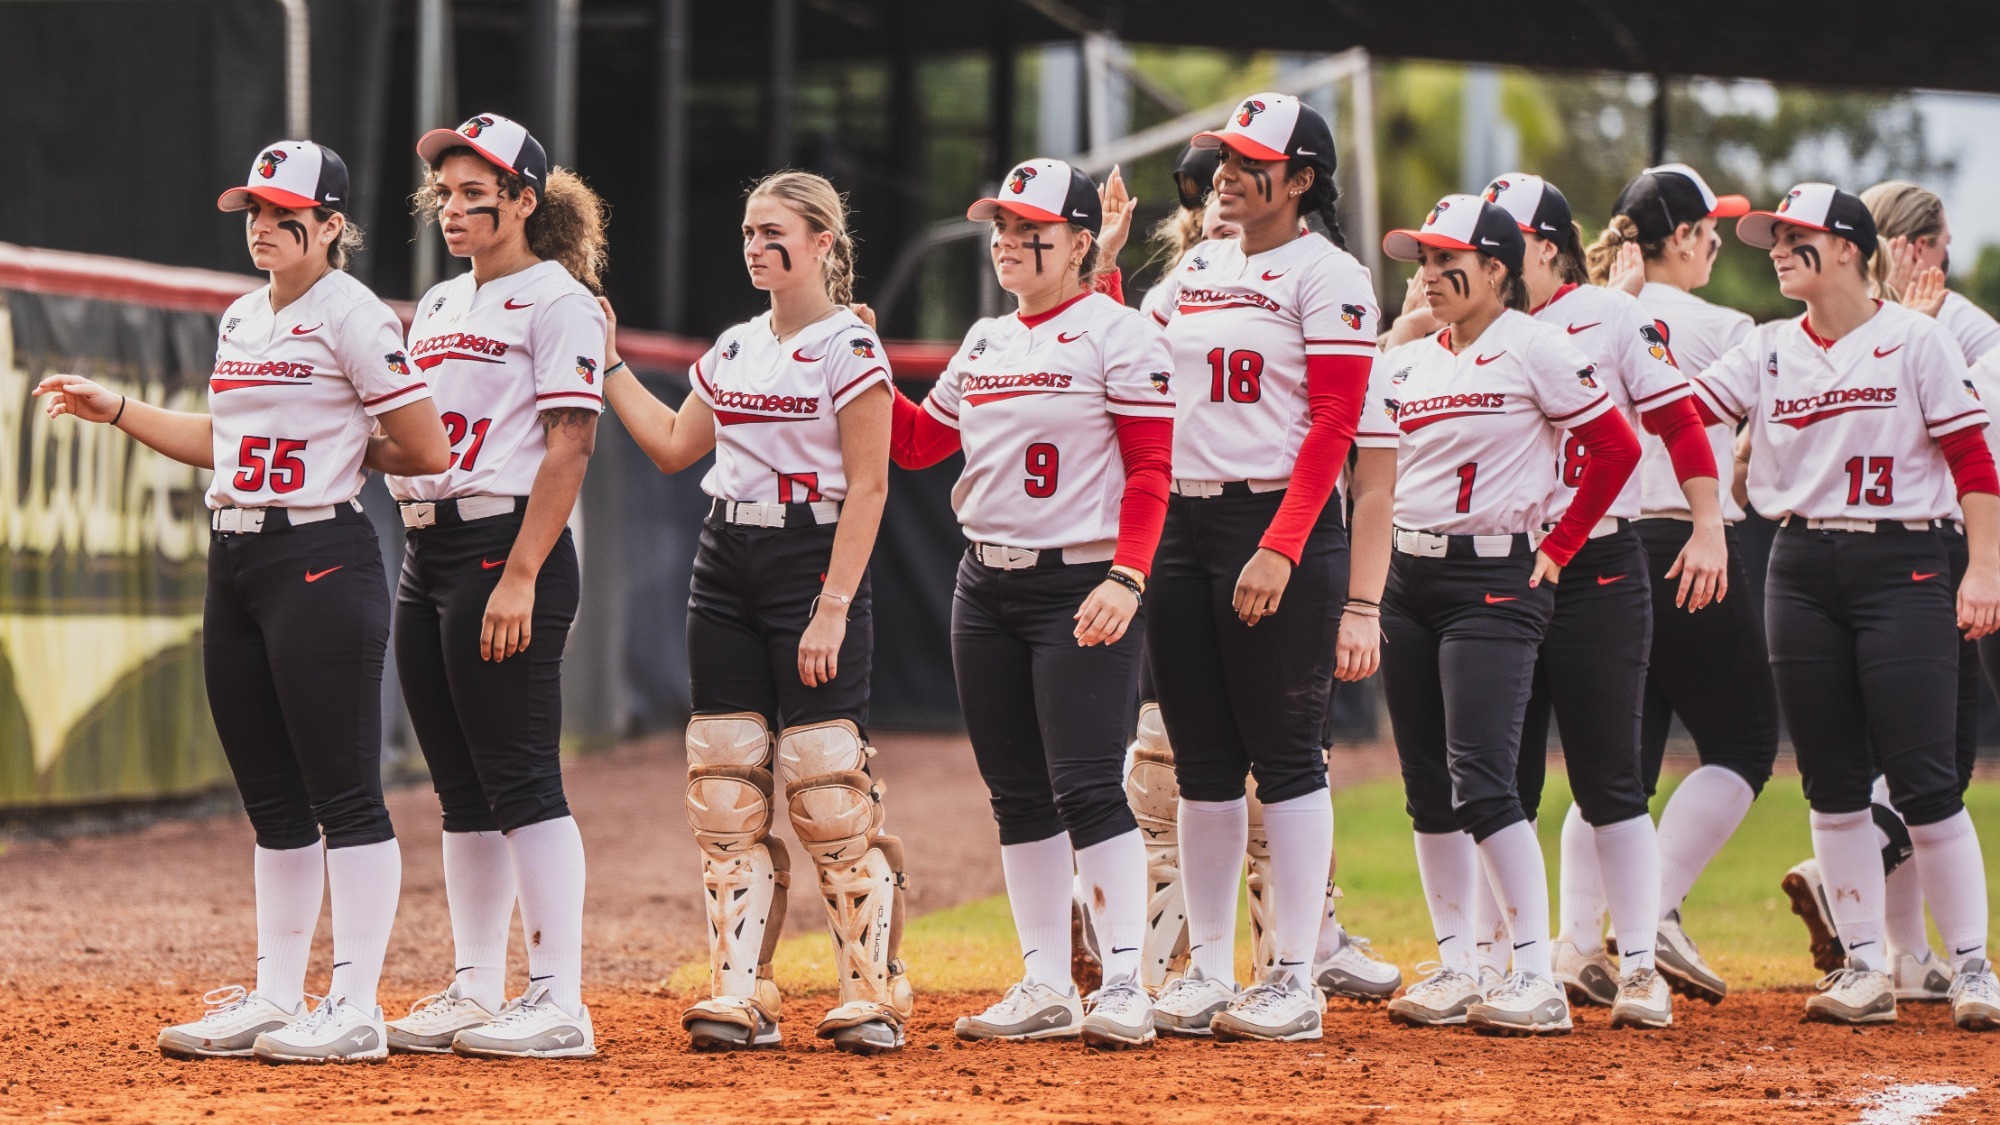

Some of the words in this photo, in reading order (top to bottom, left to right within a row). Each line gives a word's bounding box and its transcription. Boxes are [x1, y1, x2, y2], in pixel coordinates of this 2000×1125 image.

[214, 361, 314, 378] uccaneers
[1207, 347, 1264, 403] 18
[1399, 393, 1505, 417] ccaneers
[233, 436, 308, 494] 55
[440, 411, 492, 472] 21
[1024, 443, 1059, 498] 9
[1455, 462, 1478, 513] 1
[1845, 456, 1894, 507] 13
